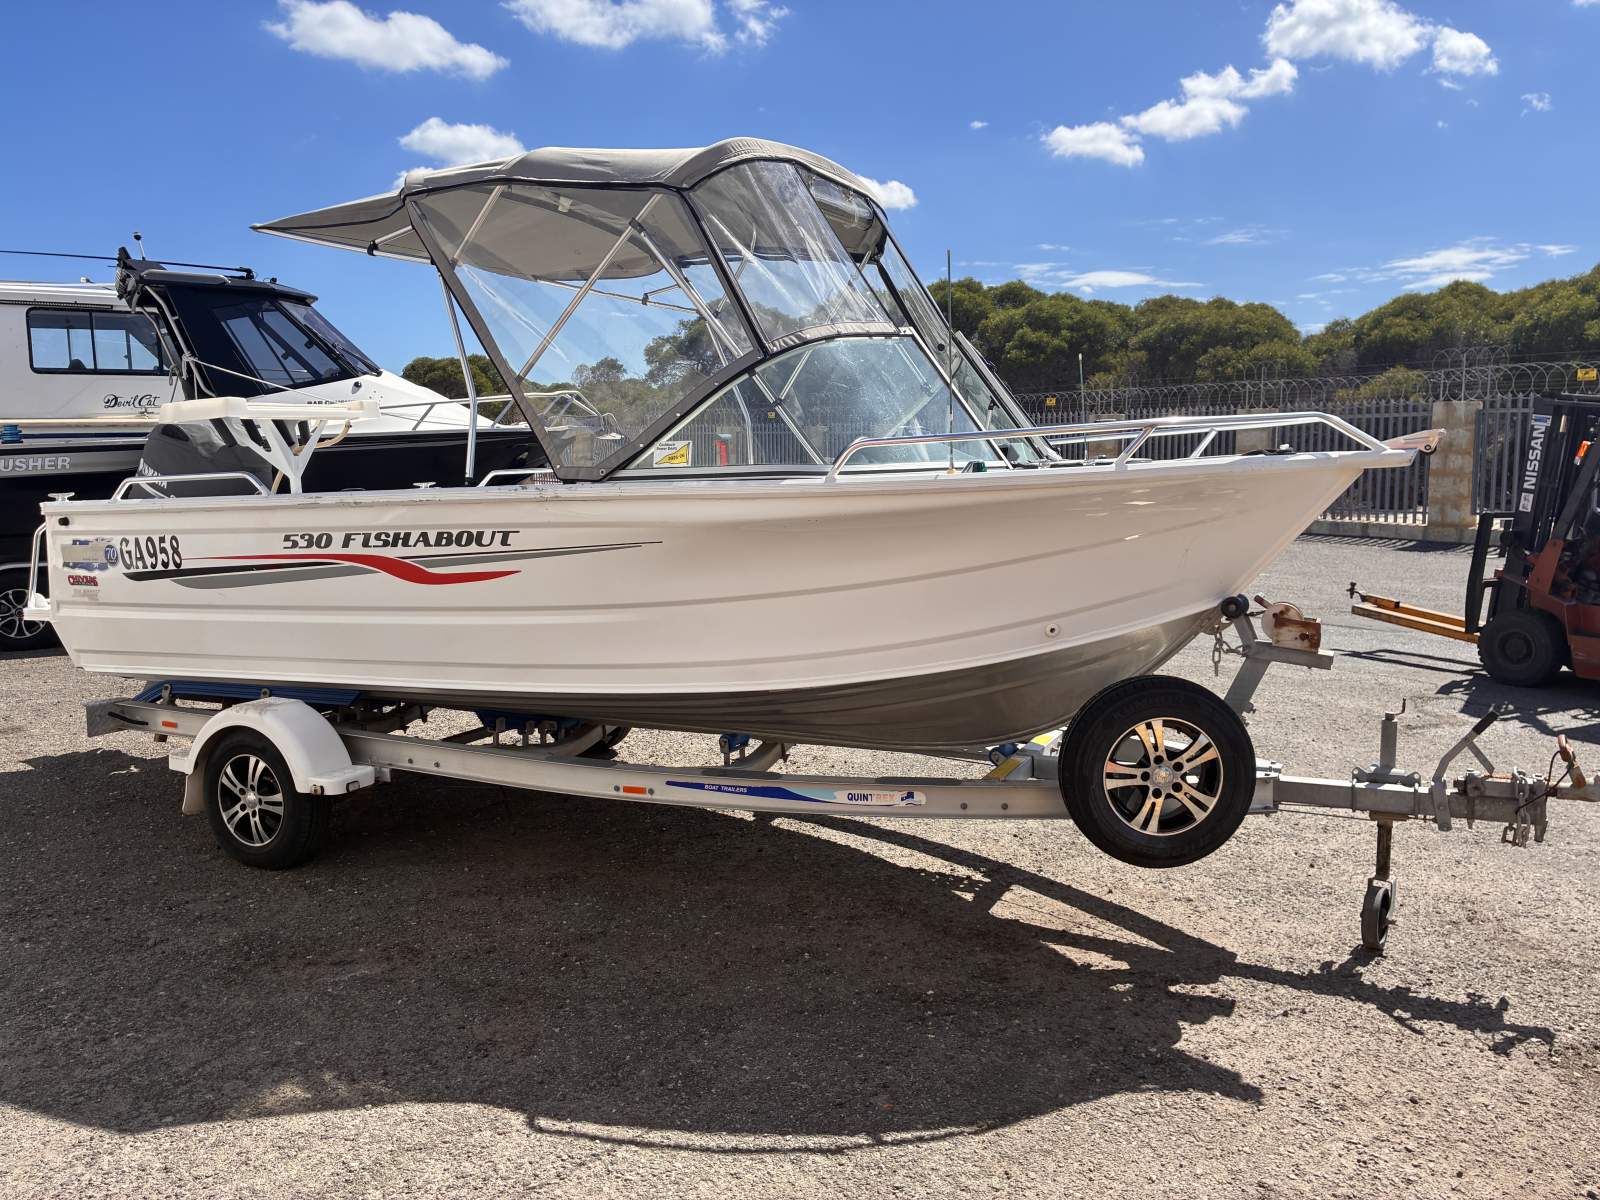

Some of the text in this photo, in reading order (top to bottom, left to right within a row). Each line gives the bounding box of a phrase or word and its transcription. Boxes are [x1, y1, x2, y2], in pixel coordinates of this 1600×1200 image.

[103, 393, 160, 409] Devil Cat
[1523, 425, 1546, 489] NISSAN
[119, 534, 183, 570] GA958
[282, 530, 520, 549] 530 FISHABOUT
